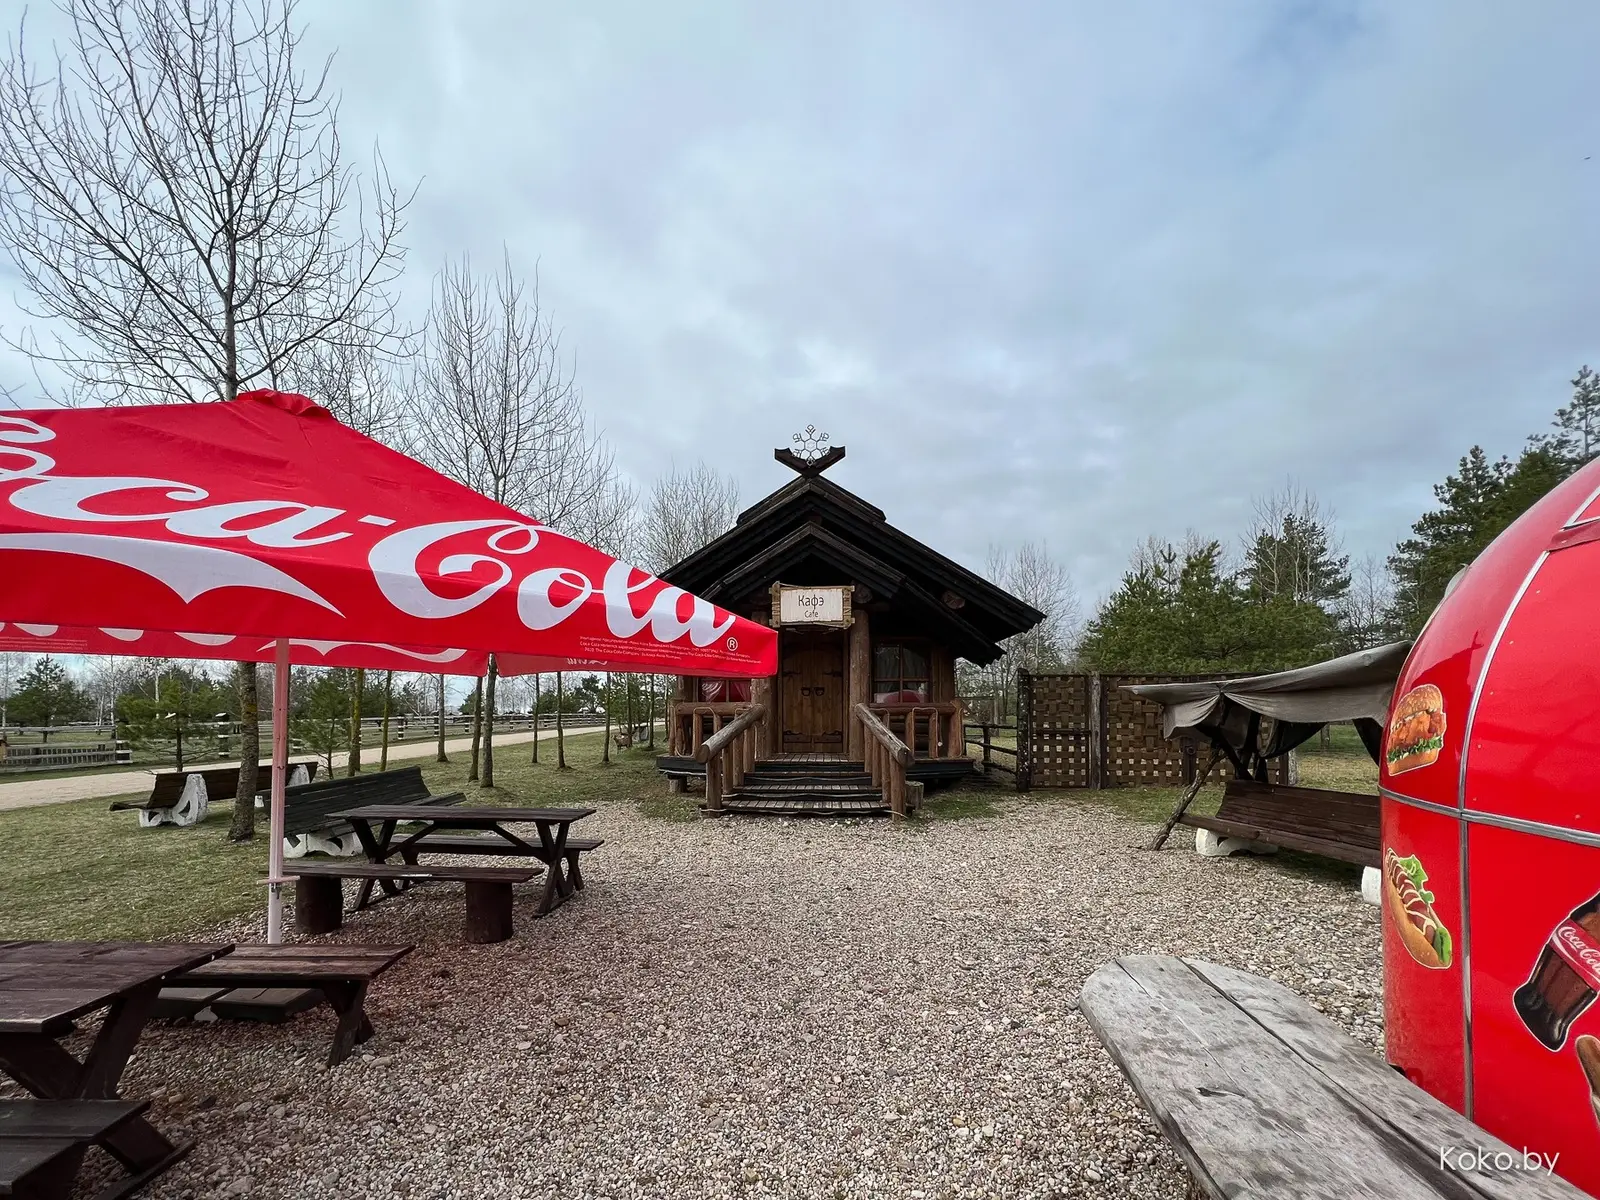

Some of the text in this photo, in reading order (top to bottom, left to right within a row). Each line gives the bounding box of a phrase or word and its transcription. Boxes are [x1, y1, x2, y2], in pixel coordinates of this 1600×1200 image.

[0, 414, 736, 647] ca-Cola
[798, 594, 824, 610] Кафэ
[804, 610, 819, 618] Cafe
